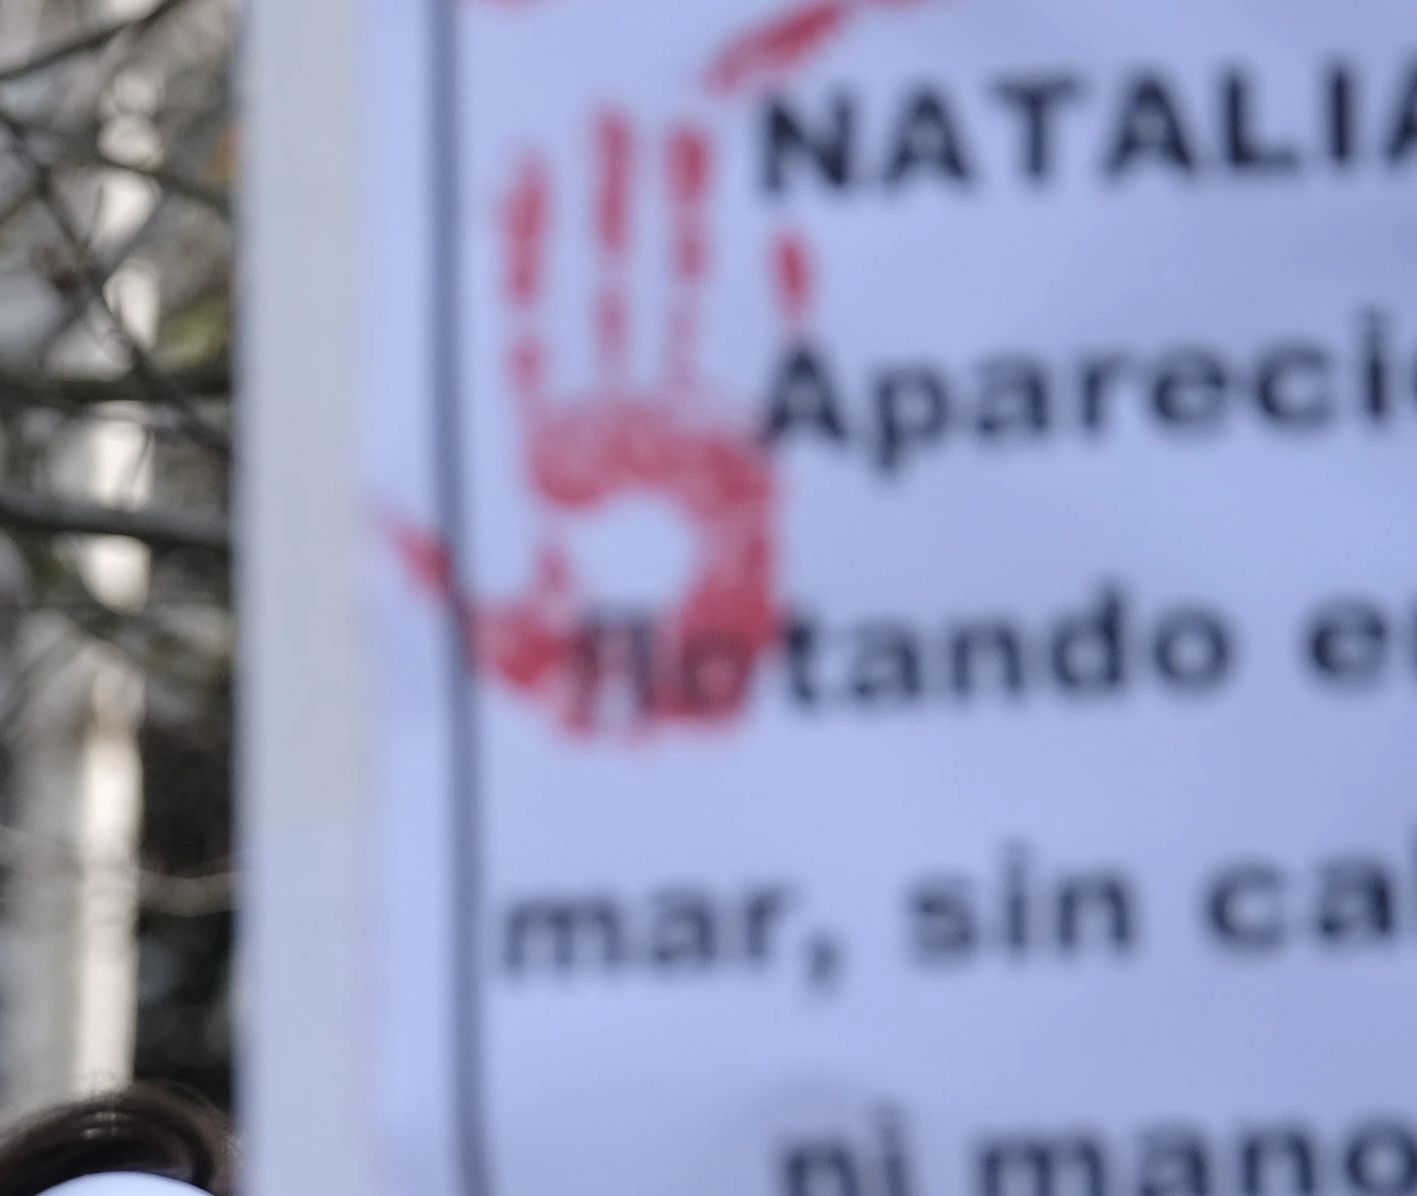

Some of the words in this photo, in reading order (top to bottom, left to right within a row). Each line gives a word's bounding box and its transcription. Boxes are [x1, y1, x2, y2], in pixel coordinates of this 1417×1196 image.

[763, 58, 1417, 190] NATALI
[757, 308, 1417, 475] Apareci
[501, 875, 841, 992] mar,
[910, 842, 1133, 958] sin
[1203, 825, 1417, 952] ca
